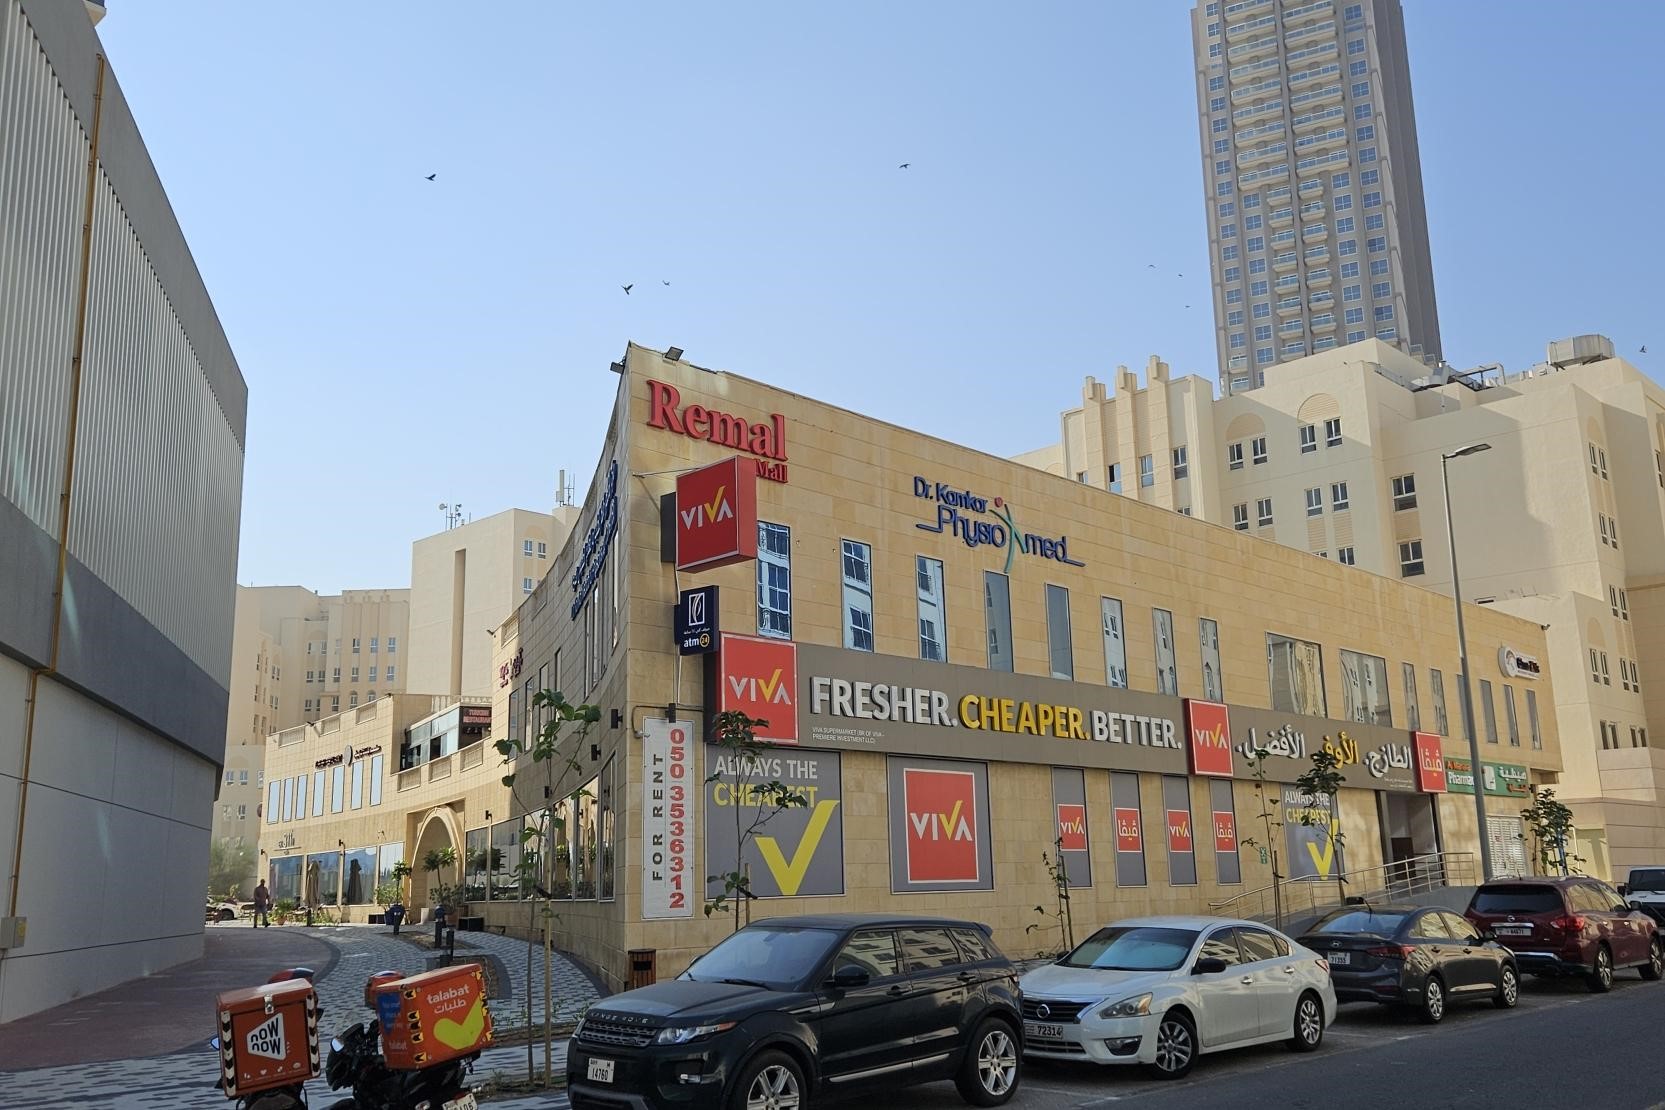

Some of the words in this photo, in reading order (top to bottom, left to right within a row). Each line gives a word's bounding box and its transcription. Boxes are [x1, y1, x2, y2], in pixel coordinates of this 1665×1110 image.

[647, 379, 788, 461] Remal
[755, 458, 788, 483] Mall
[681, 485, 733, 530] VIVA
[914, 476, 933, 500] Dr.
[936, 483, 988, 513] Kamkar
[729, 668, 791, 705] VIVA
[811, 676, 958, 727] FRESHER.
[959, 694, 1090, 740] CHEAPER.
[1091, 710, 1182, 749] BETTER.
[1195, 722, 1228, 749] VIVA
[714, 755, 781, 777] ALWAYS
[786, 760, 818, 779] THE
[652, 754, 663, 817] RENT
[1315, 792, 1331, 806] THE
[910, 800, 973, 841] VIVA
[1060, 817, 1084, 834] VIVA
[1170, 821, 1190, 837] VIVA
[652, 833, 663, 881] FOR
[427, 984, 470, 1004] talabat
[434, 999, 466, 1013] طلبات
